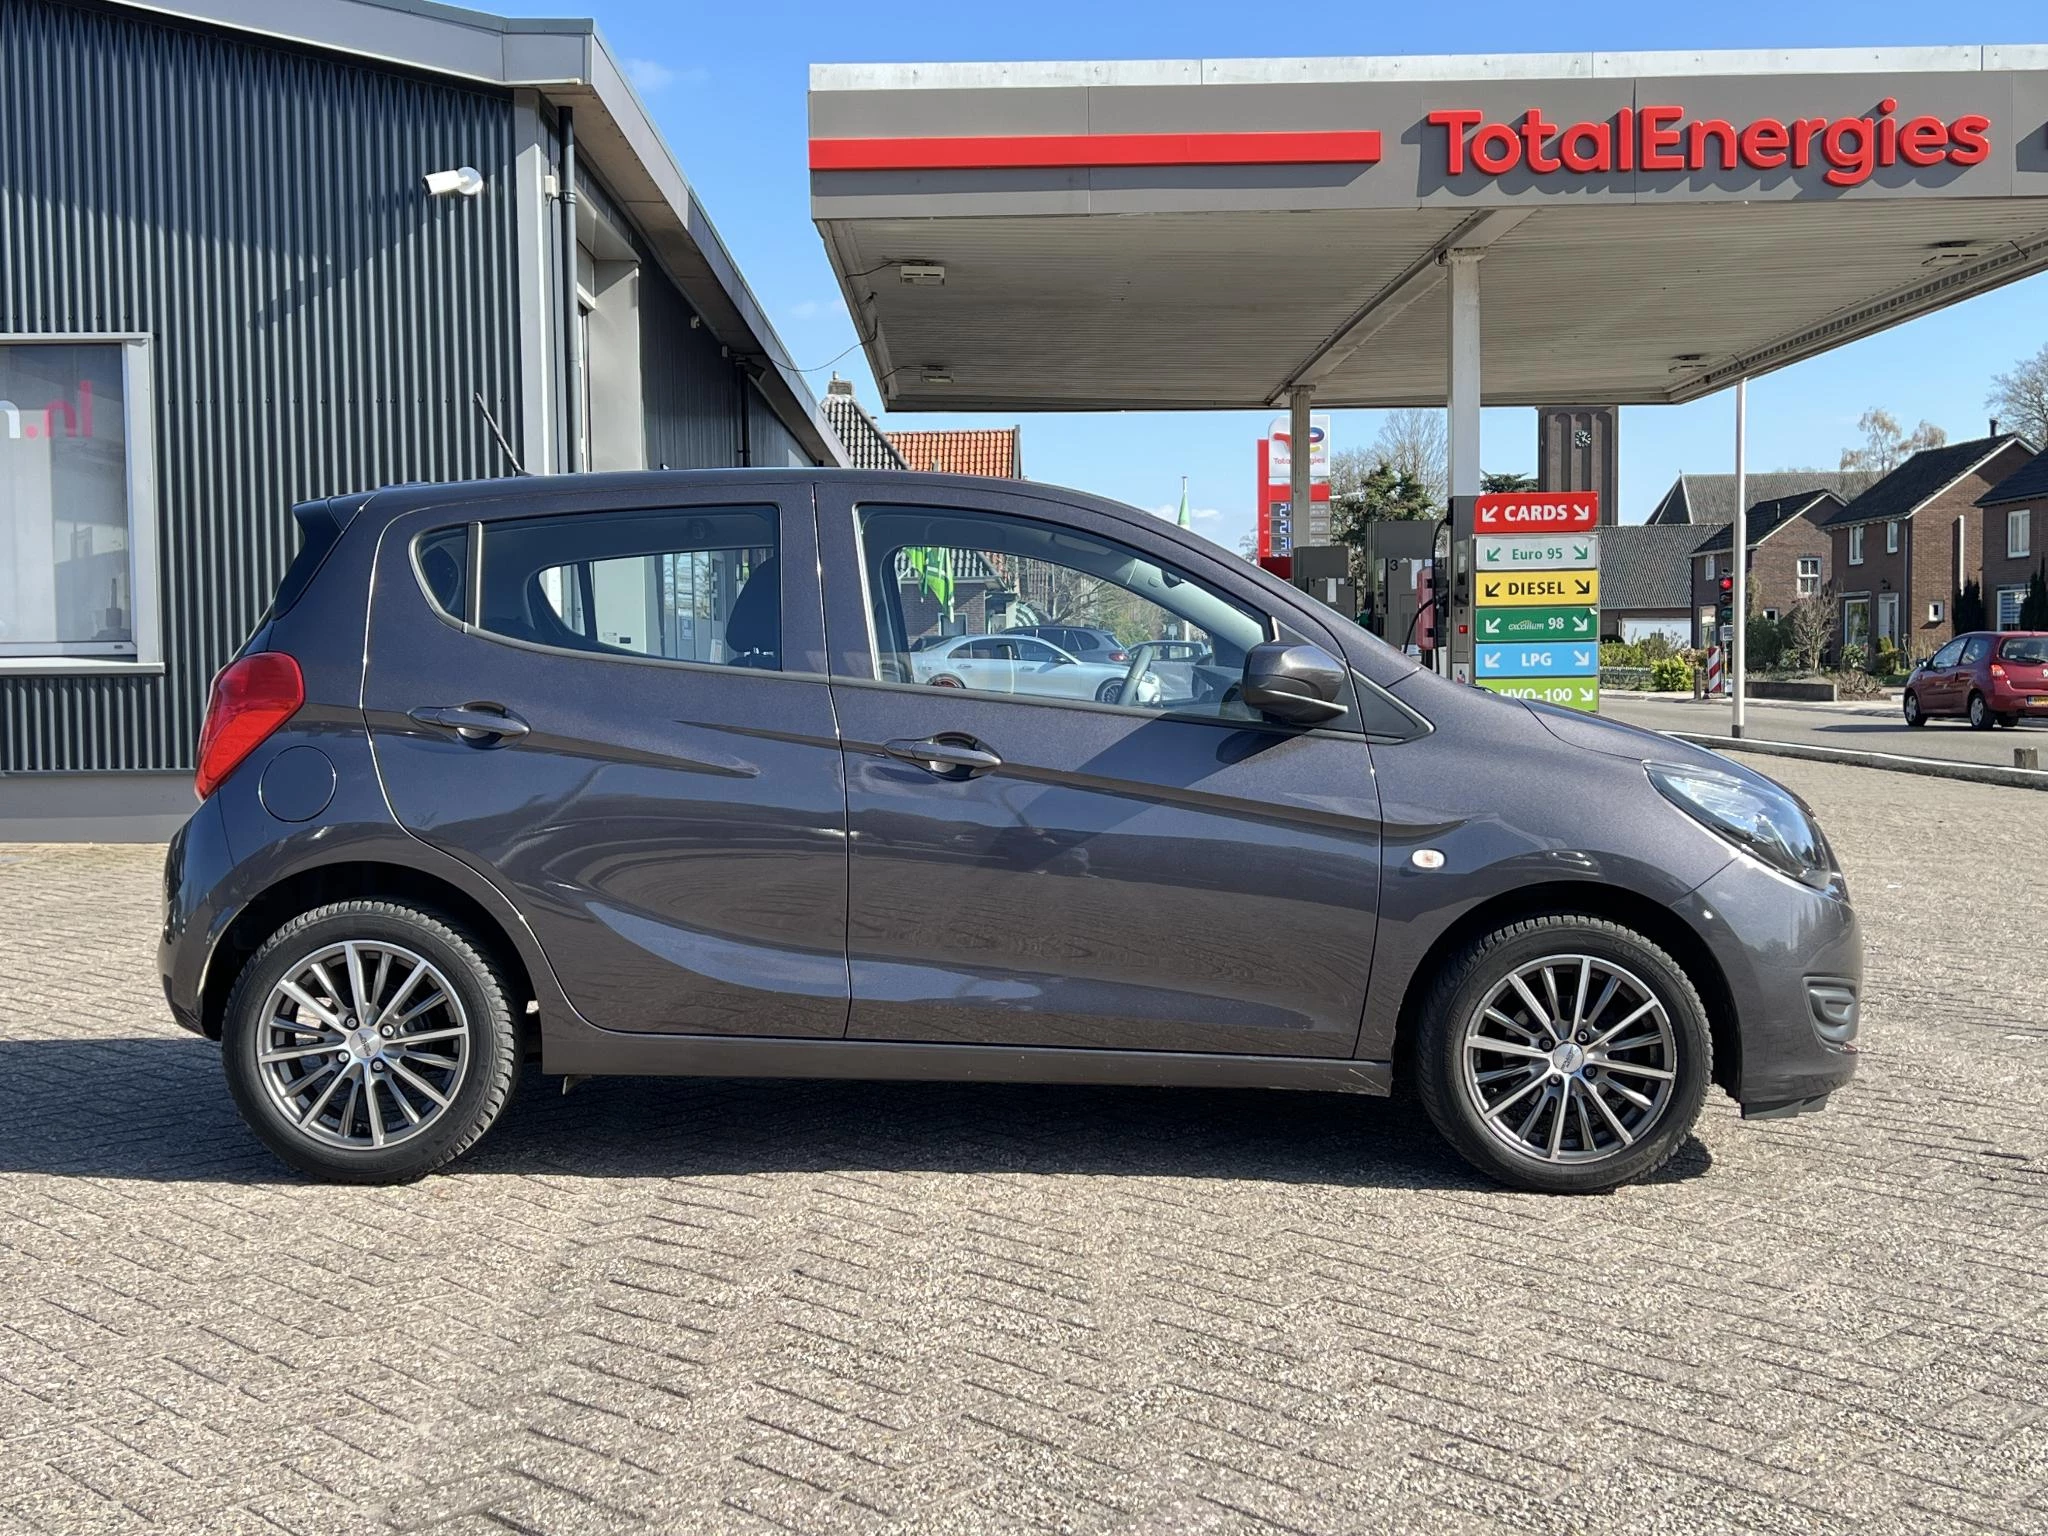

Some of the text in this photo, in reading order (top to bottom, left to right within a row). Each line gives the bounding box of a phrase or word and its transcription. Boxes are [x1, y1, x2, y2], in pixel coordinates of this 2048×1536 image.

[1427, 97, 1992, 187] TotalEnergies
[1504, 504, 1568, 522] CARDS
[1512, 547, 1563, 560] Euro 95
[1390, 559, 1398, 571] 3
[1347, 577, 1354, 587] 2
[1508, 581, 1565, 596] DIESEL
[1548, 617, 1564, 630] 98
[1521, 653, 1552, 667] LPG
